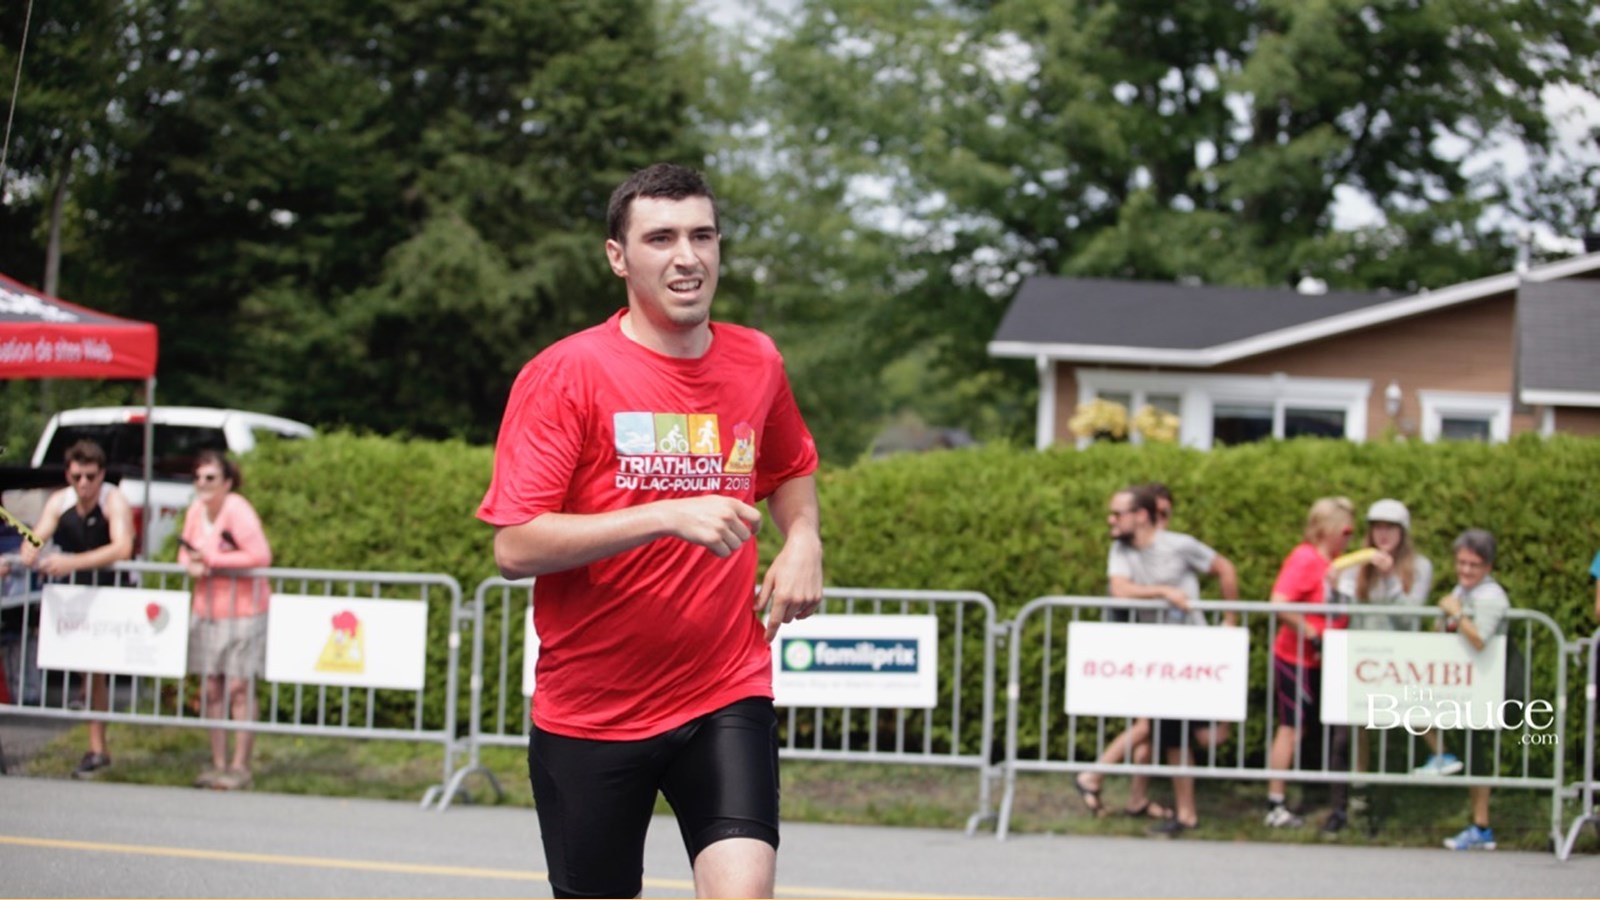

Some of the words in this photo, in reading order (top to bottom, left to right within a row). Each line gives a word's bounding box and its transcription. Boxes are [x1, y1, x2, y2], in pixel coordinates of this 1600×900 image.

[616, 456, 723, 475] TRIATHLON
[615, 475, 638, 490] DU
[640, 477, 721, 491] LAC-POULIN
[724, 477, 750, 490] 2018
[815, 641, 916, 671] familiprix
[1354, 659, 1475, 687] CAMBI
